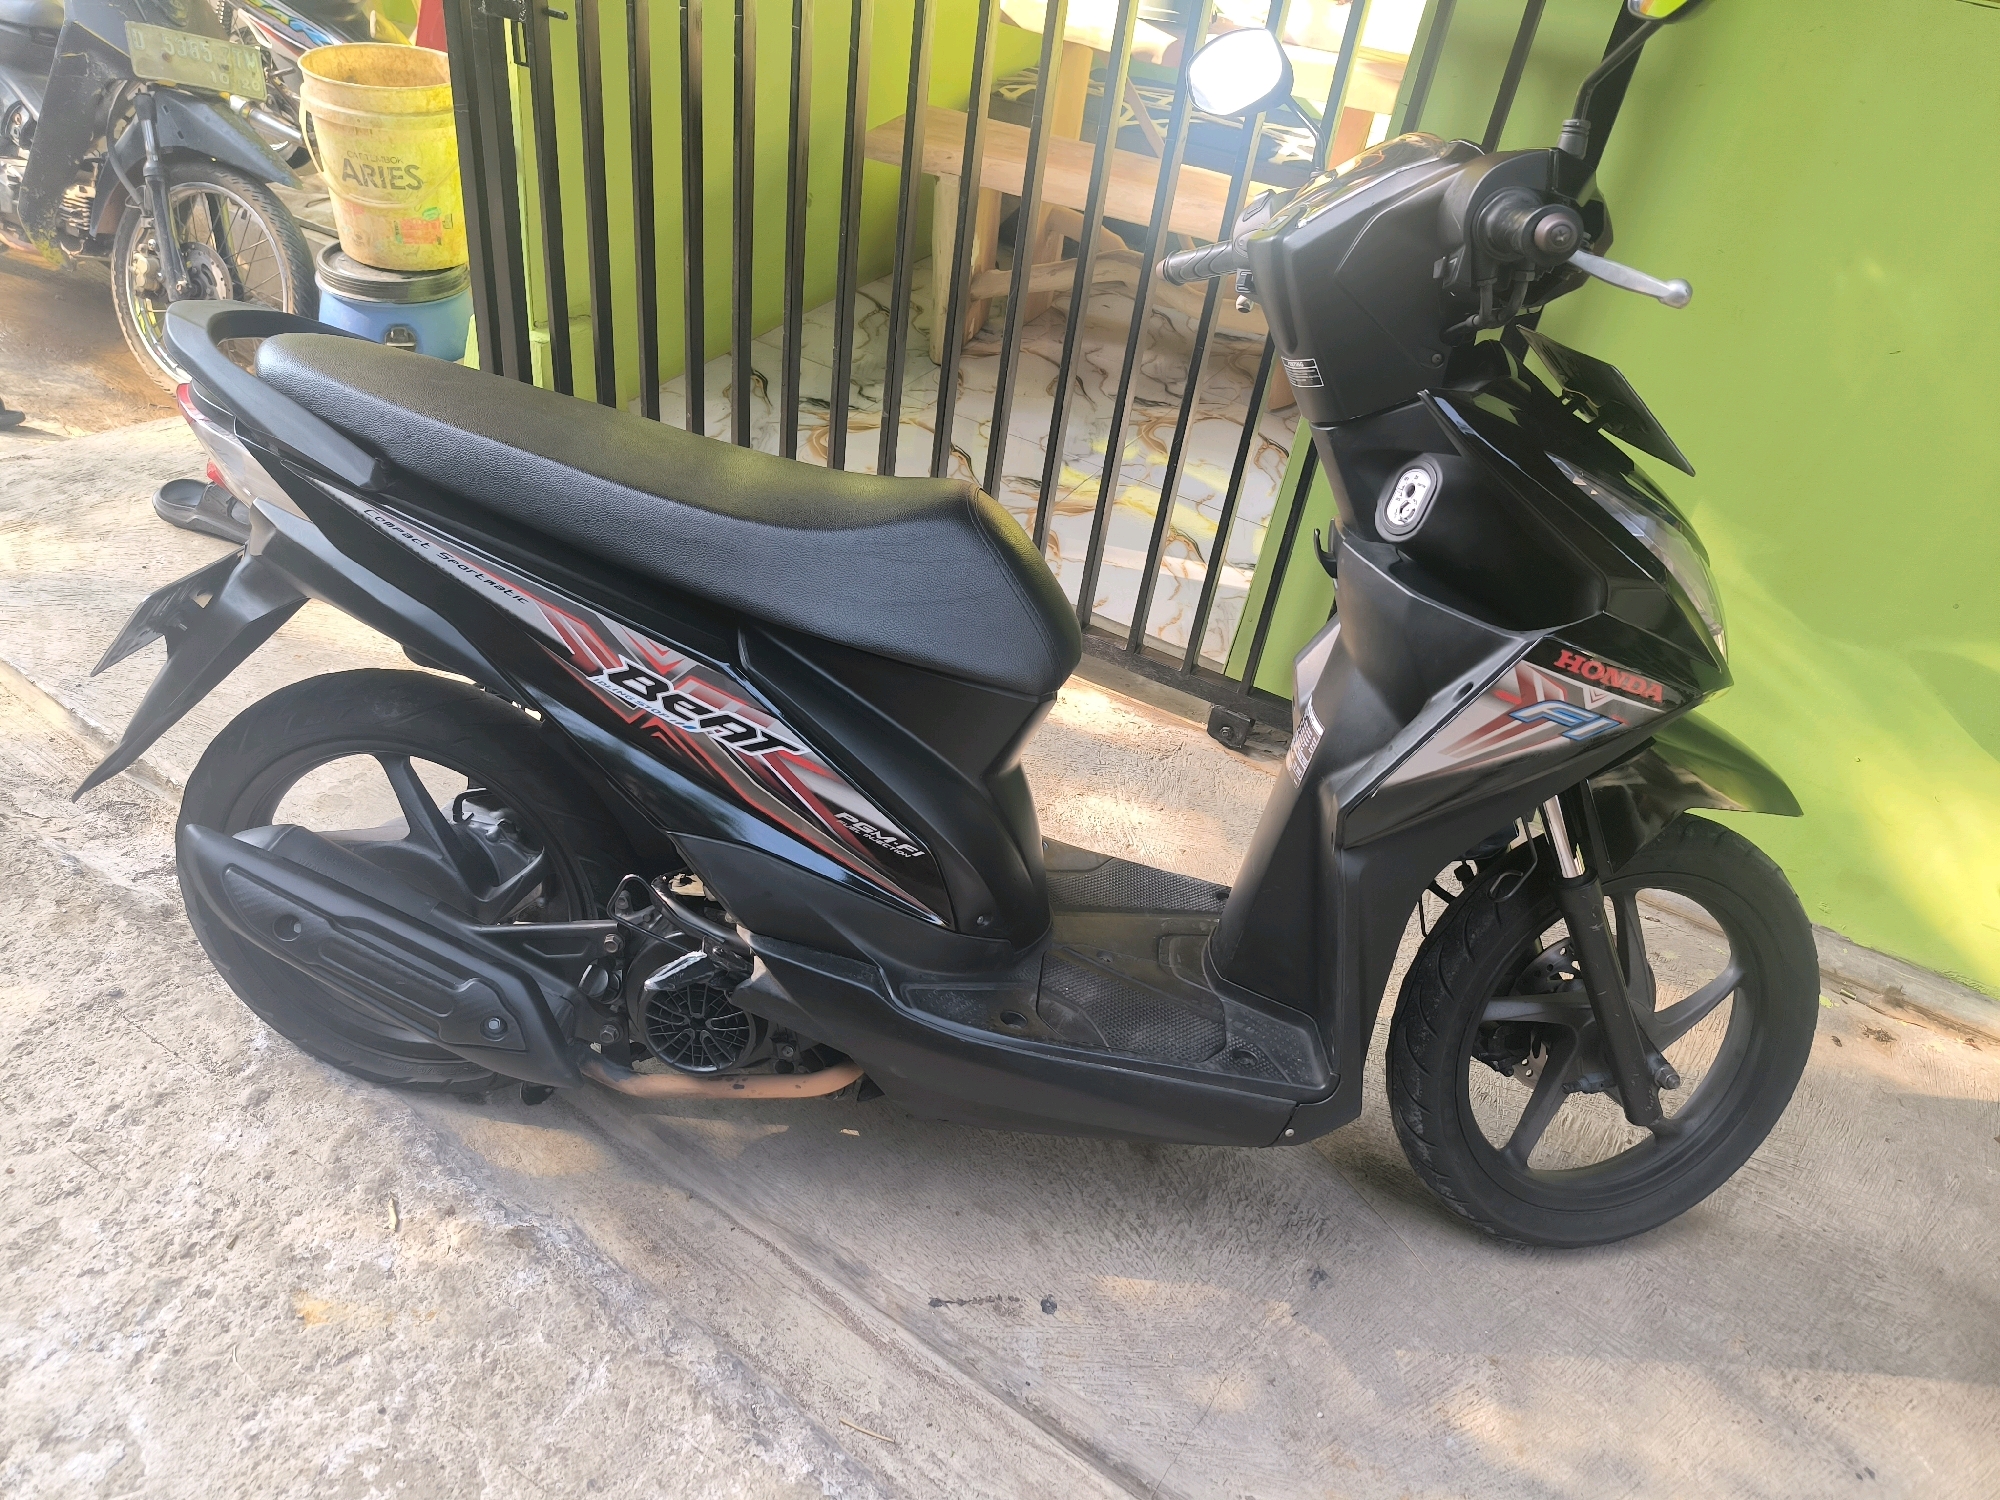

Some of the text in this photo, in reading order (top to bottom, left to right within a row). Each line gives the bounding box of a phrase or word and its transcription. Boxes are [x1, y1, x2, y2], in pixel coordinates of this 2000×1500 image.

[161, 34, 213, 62] 5385
[210, 70, 260, 91] 10 20
[342, 157, 423, 190] ARIES
[363, 509, 430, 550] Compact
[1553, 649, 1663, 703] HONDA
[592, 679, 670, 720] IDLING STOP
[836, 820, 911, 857] FUEL INJECTION
